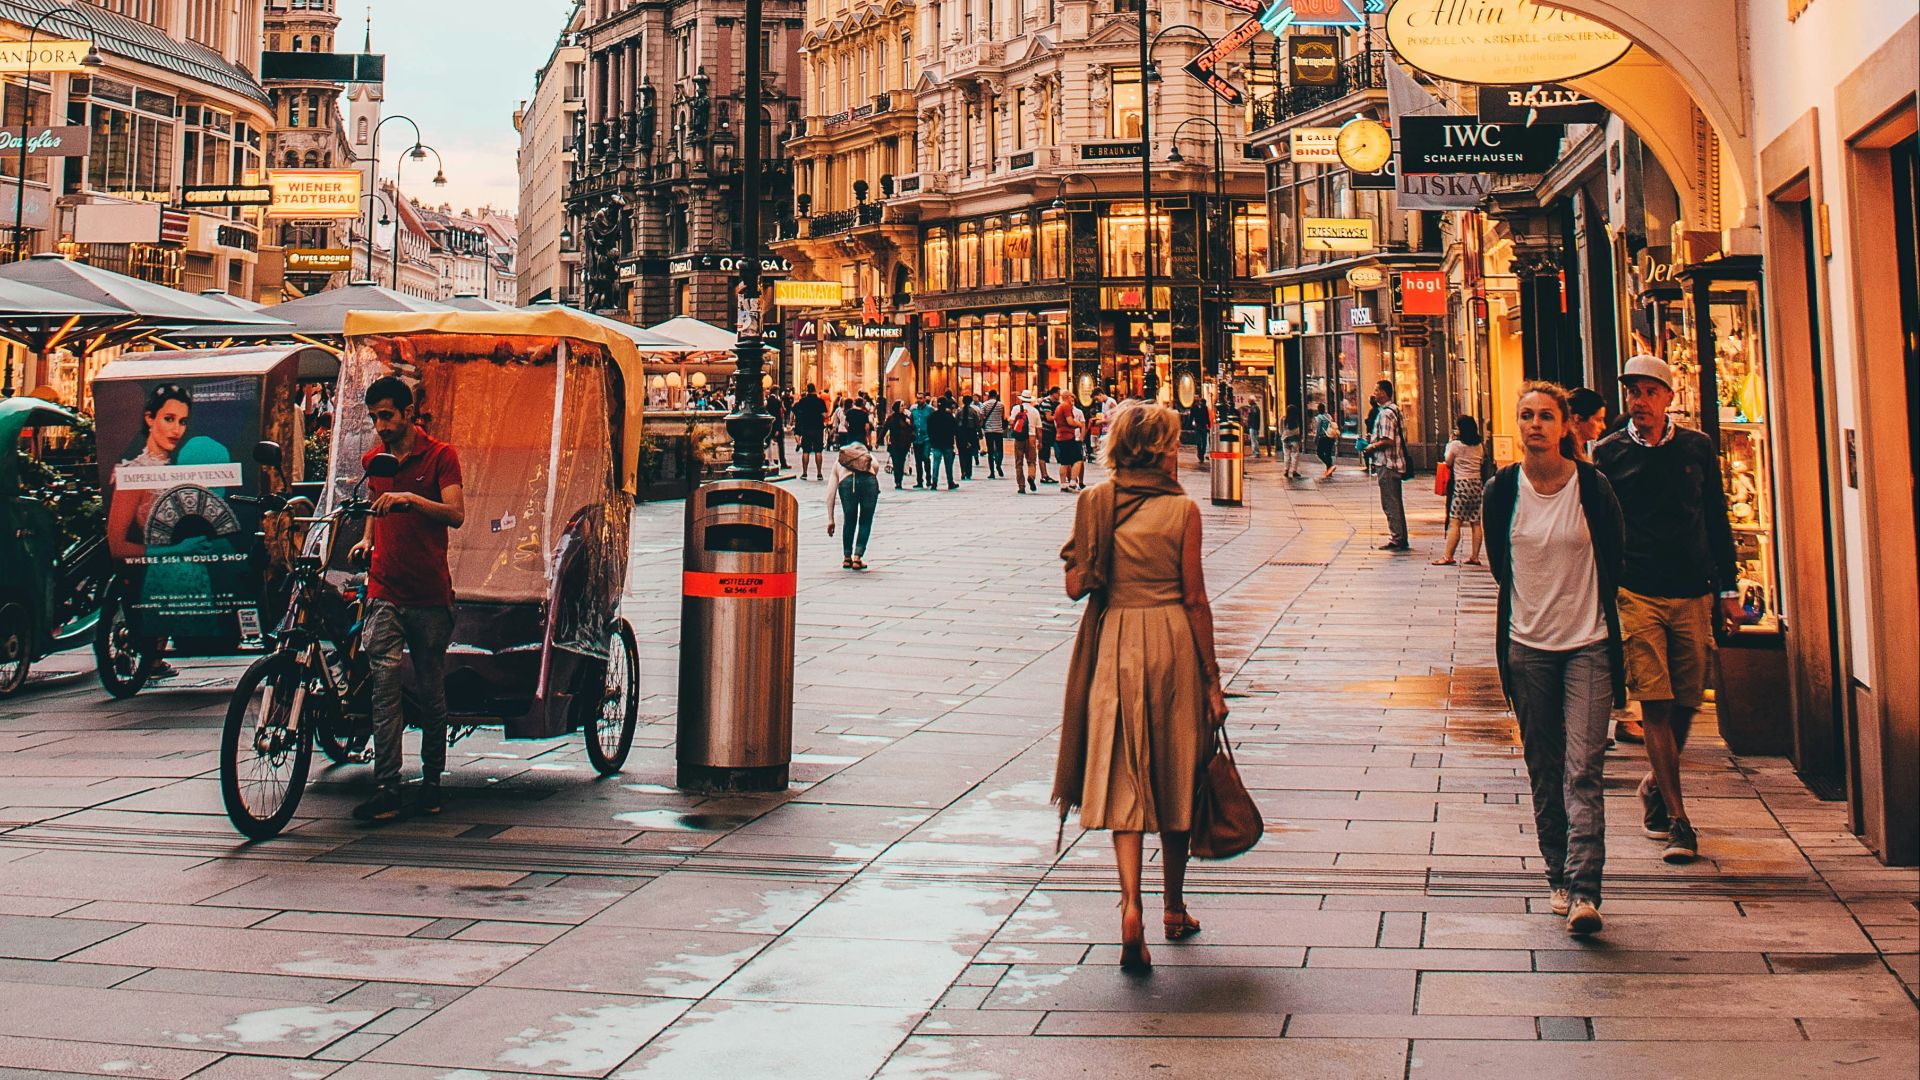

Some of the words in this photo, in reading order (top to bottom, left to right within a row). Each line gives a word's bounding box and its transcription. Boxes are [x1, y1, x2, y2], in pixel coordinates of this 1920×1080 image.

[1547, 31, 1619, 42] GESCHENKE
[1507, 91, 1580, 106] BALLY
[1443, 124, 1500, 148] IWC
[1098, 146, 1124, 156] BRAUN
[1424, 153, 1524, 163] SCHAFFHAUSEN
[289, 182, 341, 191] WIENER
[1402, 174, 1484, 196] LISKA
[124, 473, 169, 482] IMPERIAL
[170, 472, 197, 481] SHOP
[199, 470, 235, 480] VIENNA
[125, 556, 159, 565] WHERE
[162, 555, 181, 563] SISI
[183, 554, 219, 563] WOULD
[222, 553, 249, 562] SHOP
